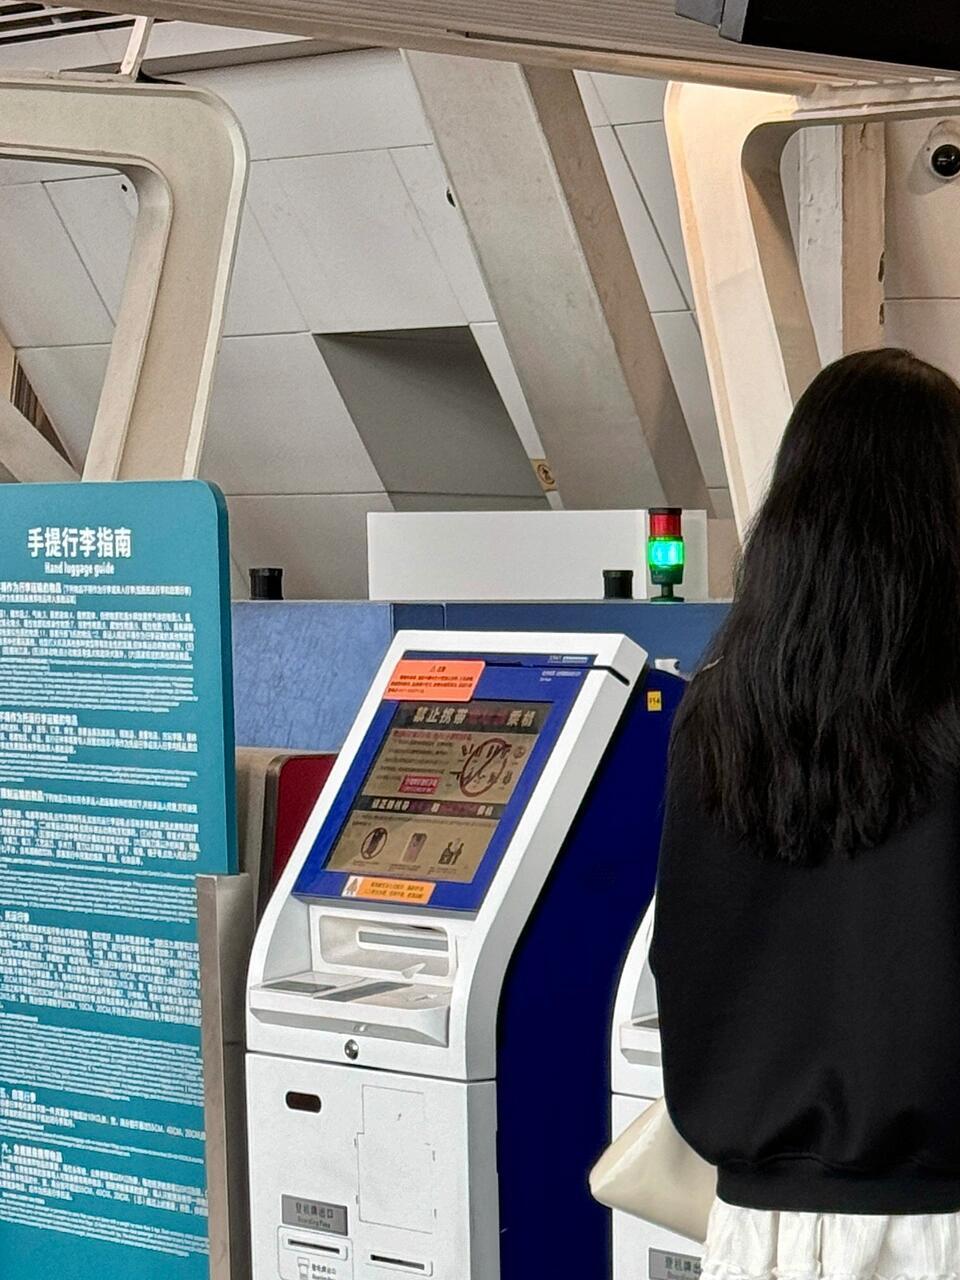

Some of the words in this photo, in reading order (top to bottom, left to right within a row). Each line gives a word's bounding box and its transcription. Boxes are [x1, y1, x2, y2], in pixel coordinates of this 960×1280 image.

[28, 527, 132, 558] 手提行李指南
[45, 561, 63, 575] Hand
[64, 562, 94, 577] luggage
[94, 564, 115, 577] guide
